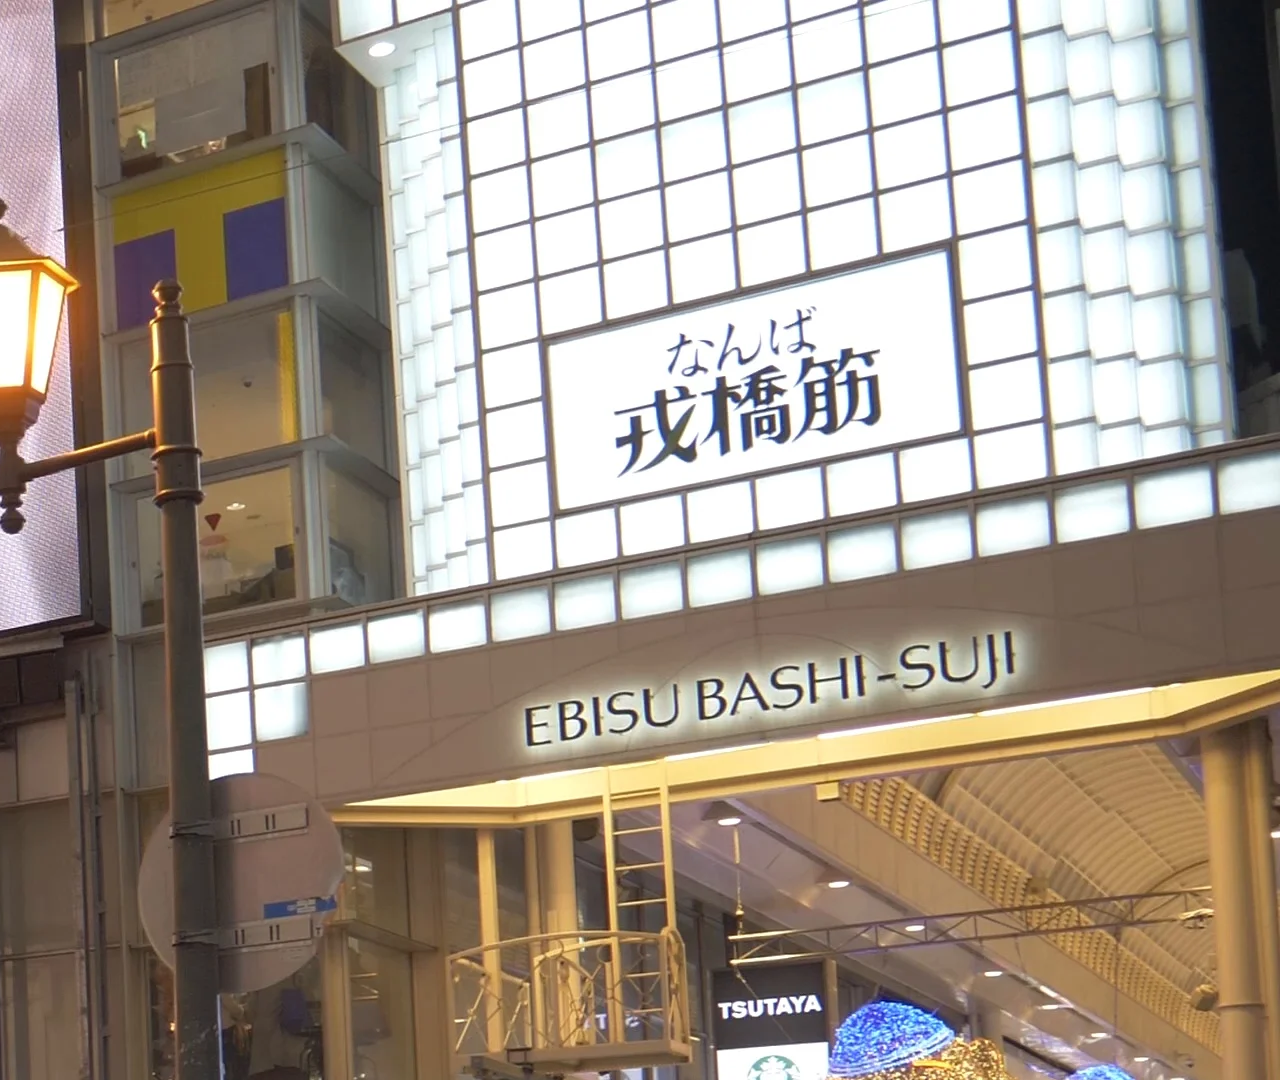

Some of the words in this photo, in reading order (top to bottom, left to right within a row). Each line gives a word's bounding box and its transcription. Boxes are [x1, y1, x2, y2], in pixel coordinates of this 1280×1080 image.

[666, 305, 818, 378] なんば
[613, 347, 882, 479] 戎橋筋
[524, 682, 681, 748] EBISU
[696, 629, 1018, 721] BASHI-SUJI
[717, 994, 822, 1020] TSUTAYA
